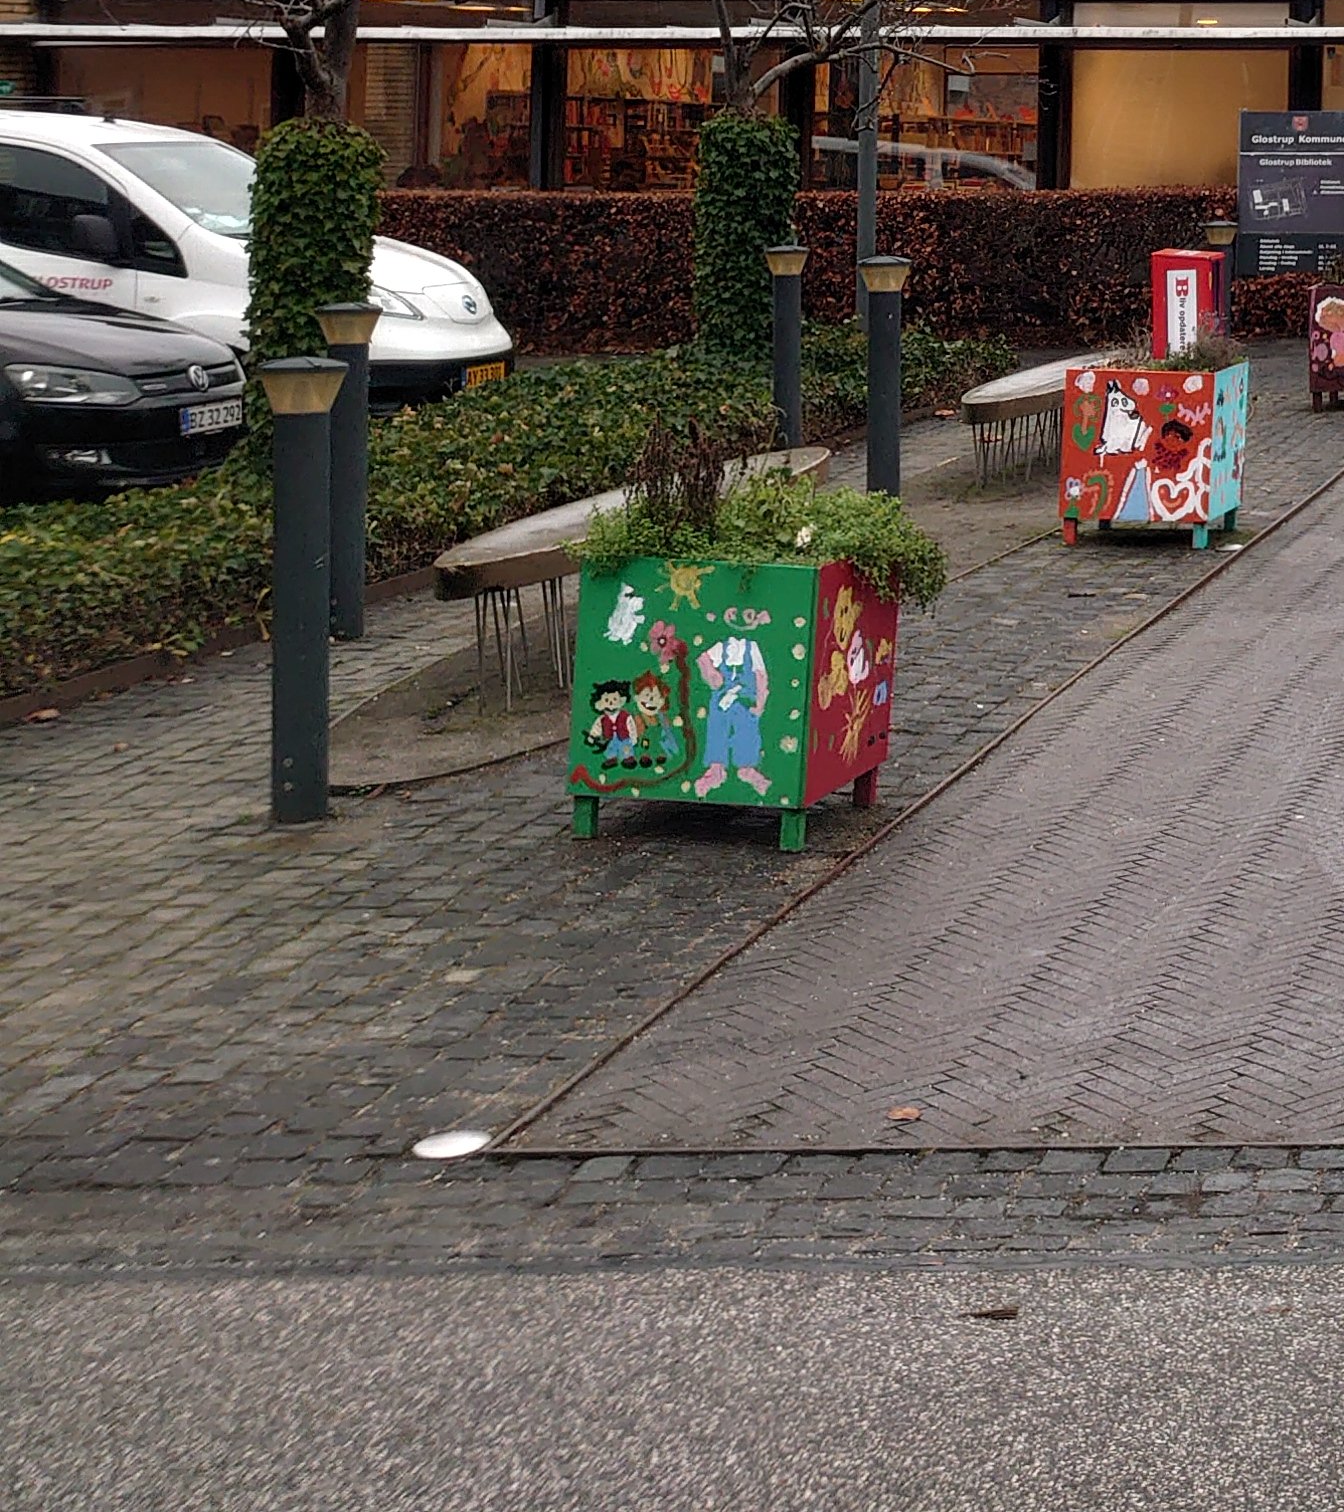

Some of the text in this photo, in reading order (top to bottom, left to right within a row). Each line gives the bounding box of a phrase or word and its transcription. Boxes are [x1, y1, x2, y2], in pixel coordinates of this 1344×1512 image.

[1251, 135, 1295, 145] Glostrup
[1259, 159, 1295, 167] Glostrup
[190, 404, 241, 429] BZ 32 292
